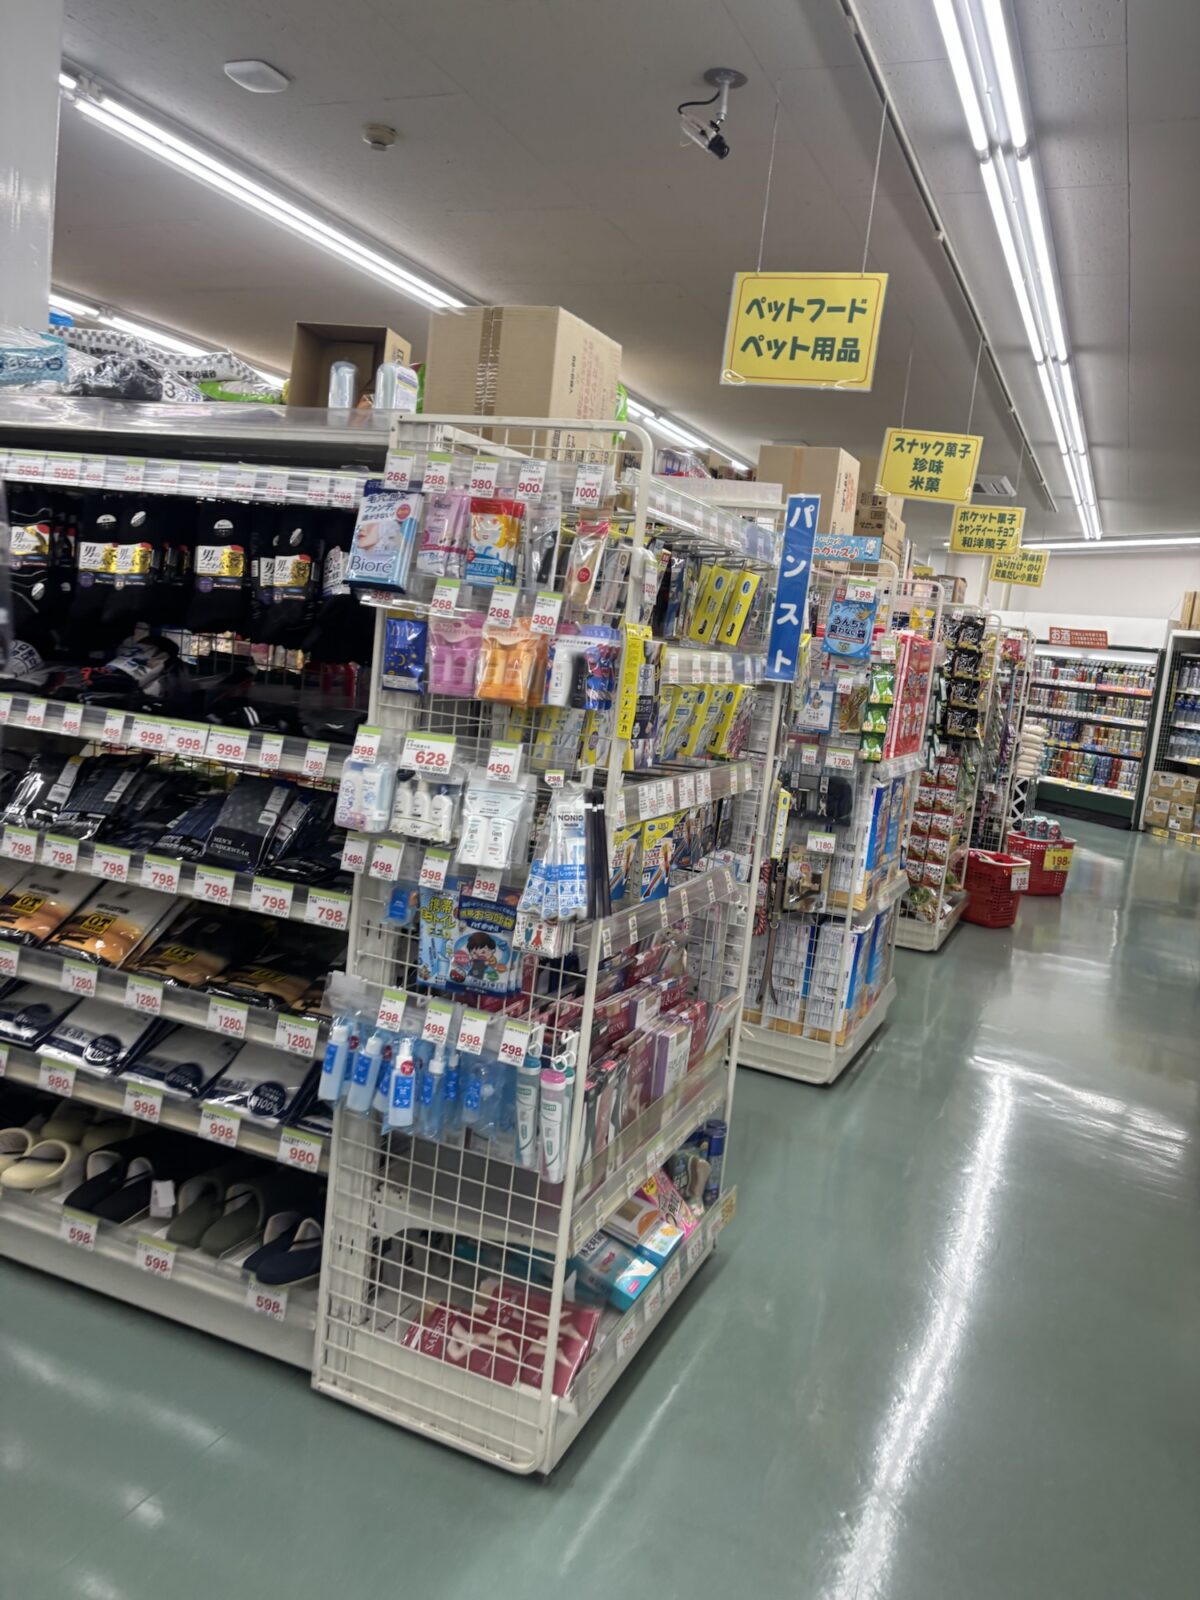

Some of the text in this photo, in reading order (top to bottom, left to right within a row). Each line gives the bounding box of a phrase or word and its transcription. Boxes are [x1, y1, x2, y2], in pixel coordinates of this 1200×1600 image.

[745, 297, 868, 324] ペットフード
[740, 336, 861, 363] ペット用品
[892, 436, 972, 459] スナック菓子
[911, 457, 944, 474] 珍味
[387, 471, 408, 482] 268
[424, 474, 445, 486] 288
[909, 475, 940, 492] 米菓
[471, 479, 492, 490] 380
[518, 482, 540, 493] 900
[576, 487, 598, 498] 1000
[960, 511, 1016, 524] ポケット菓子
[958, 524, 1015, 538] キャンディー・チョコ
[961, 536, 1008, 550] 和洋菓子
[350, 556, 392, 573] Bioré
[774, 504, 816, 674] パンスト
[854, 589, 871, 599] 198
[432, 598, 452, 610] 268
[490, 608, 510, 618] 268
[533, 614, 554, 626] 380
[140, 731, 164, 744] 998
[176, 736, 201, 750] 998
[216, 743, 241, 756] 998
[354, 745, 375, 757] 598
[415, 751, 446, 766] 628
[488, 764, 510, 774] 450
[11, 842, 32, 855] 798
[52, 851, 73, 864] 798
[102, 861, 124, 876] 798
[372, 860, 392, 872] 498
[152, 872, 174, 886] 798
[421, 870, 442, 882] 398
[204, 882, 228, 898] 798
[474, 880, 496, 892] 398
[262, 894, 286, 910] 798
[318, 906, 342, 923] 798
[70, 975, 94, 990] 1280
[136, 992, 158, 1007] 1280
[218, 1014, 242, 1030] 1280
[379, 1010, 398, 1023] 298
[424, 1022, 446, 1035] 498
[286, 1032, 311, 1049] 1280
[460, 1032, 480, 1046] 598
[501, 1042, 522, 1057] 298
[48, 1074, 70, 1090] 980
[134, 1100, 157, 1116] 998
[210, 1122, 234, 1140] 998
[290, 1146, 315, 1164] 980
[68, 1227, 90, 1242] 598
[144, 1254, 169, 1272] 598
[256, 1295, 281, 1313] 598
